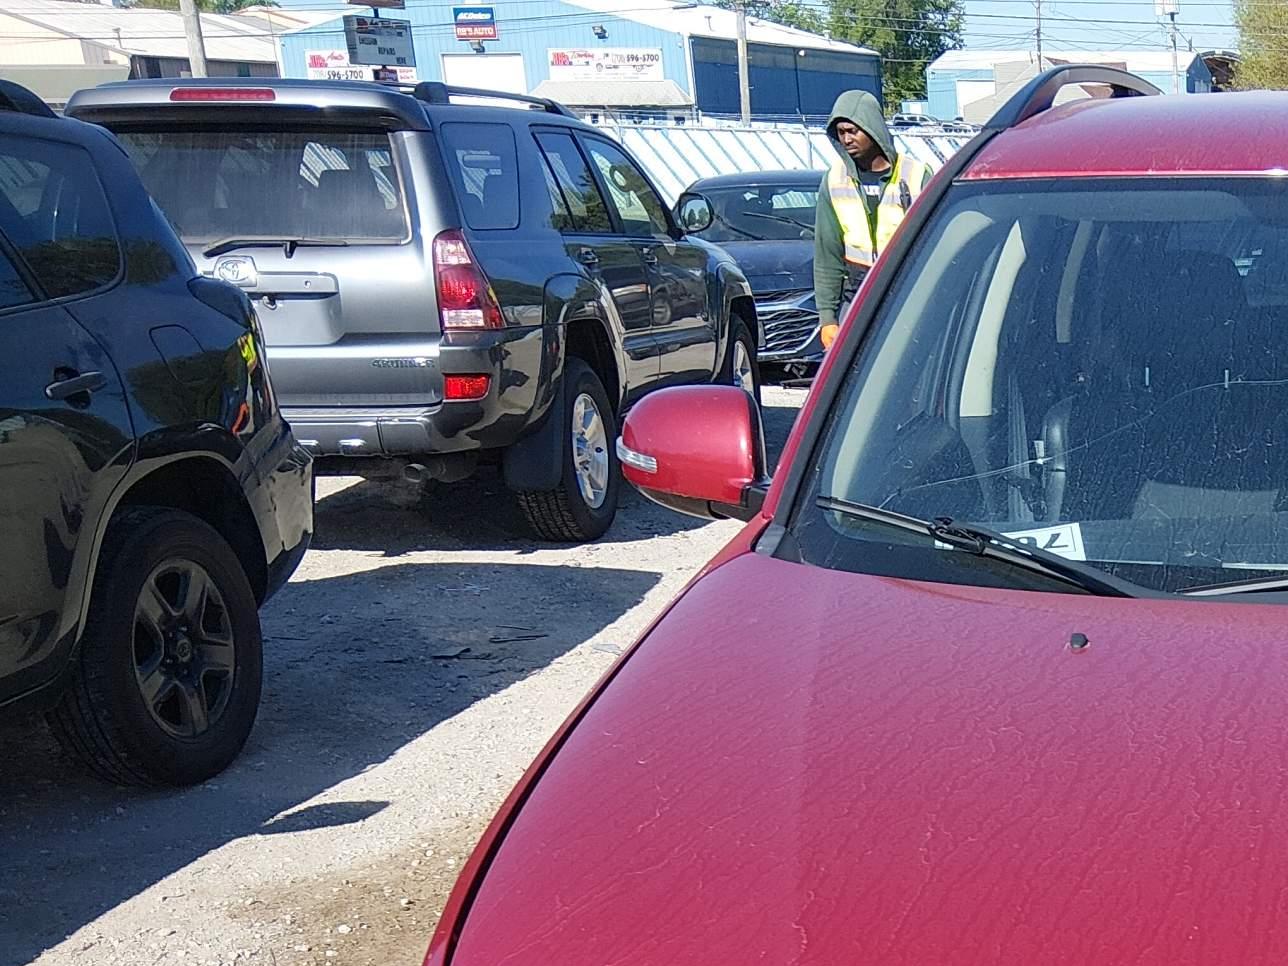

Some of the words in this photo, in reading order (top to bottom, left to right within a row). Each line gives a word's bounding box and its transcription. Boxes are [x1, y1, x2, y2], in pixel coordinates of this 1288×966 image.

[473, 26, 494, 36] AUTO
[626, 54, 660, 63] 596-5700
[371, 358, 435, 369] 4RUNNER
